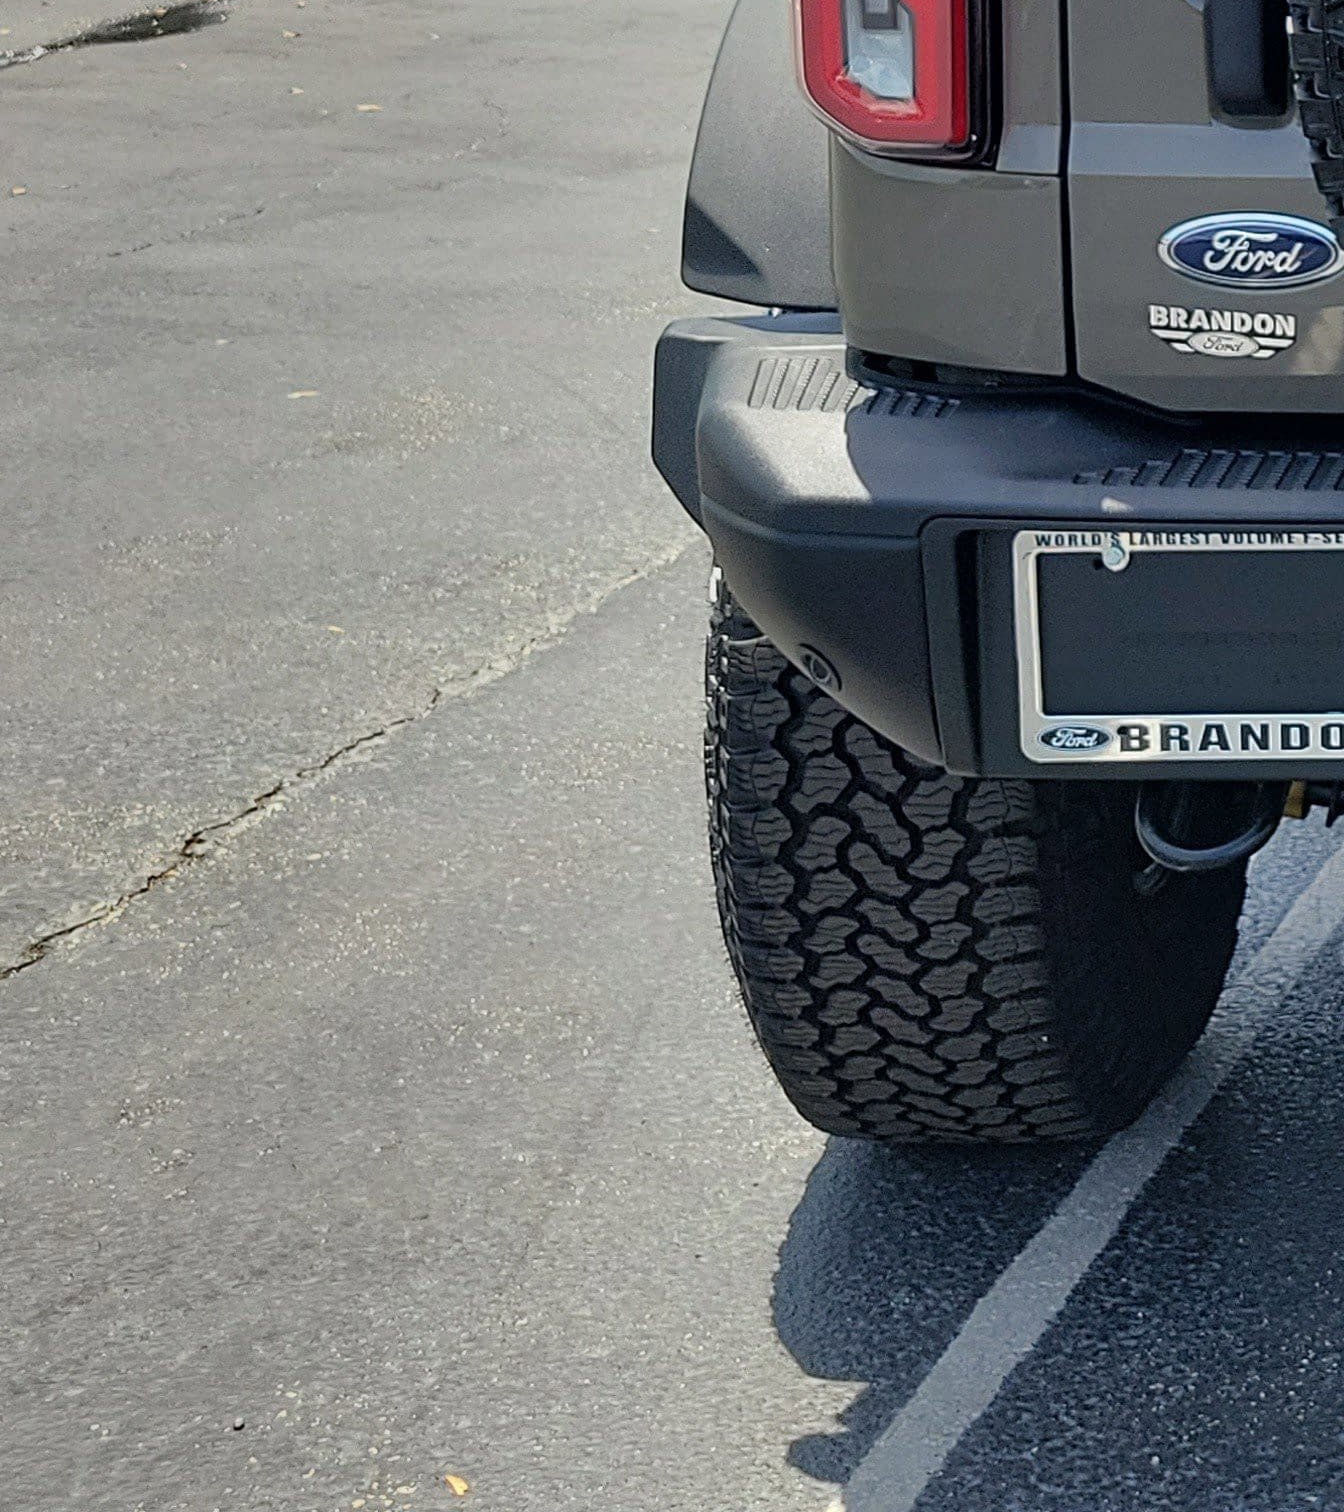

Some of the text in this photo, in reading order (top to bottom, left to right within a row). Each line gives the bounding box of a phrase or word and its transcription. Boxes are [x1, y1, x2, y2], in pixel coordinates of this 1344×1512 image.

[1203, 229, 1303, 273] Ford
[1149, 305, 1297, 337] BRANDON
[1202, 337, 1244, 352] Ford
[1051, 727, 1099, 748] Ford
